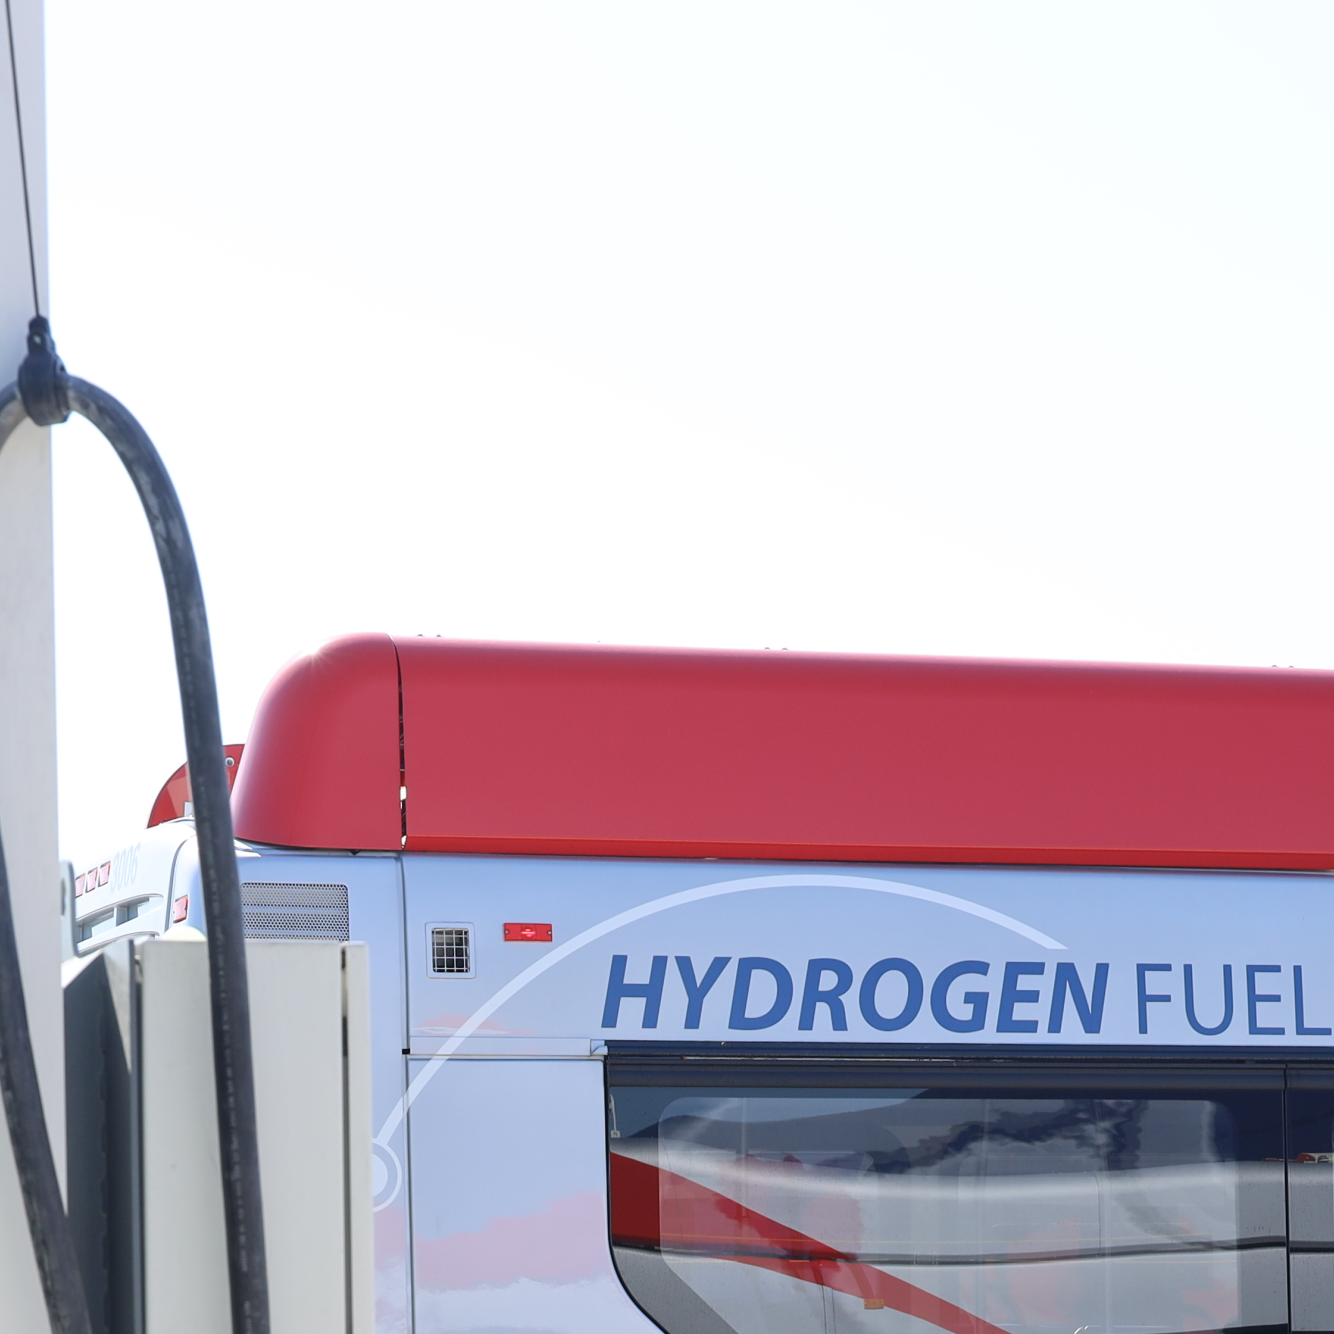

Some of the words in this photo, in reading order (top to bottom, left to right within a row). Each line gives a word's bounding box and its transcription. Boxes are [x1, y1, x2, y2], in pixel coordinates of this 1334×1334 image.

[110, 842, 141, 894] 3006
[601, 954, 1110, 1034] HYDROGEN
[1136, 963, 1332, 1036] FUEL
